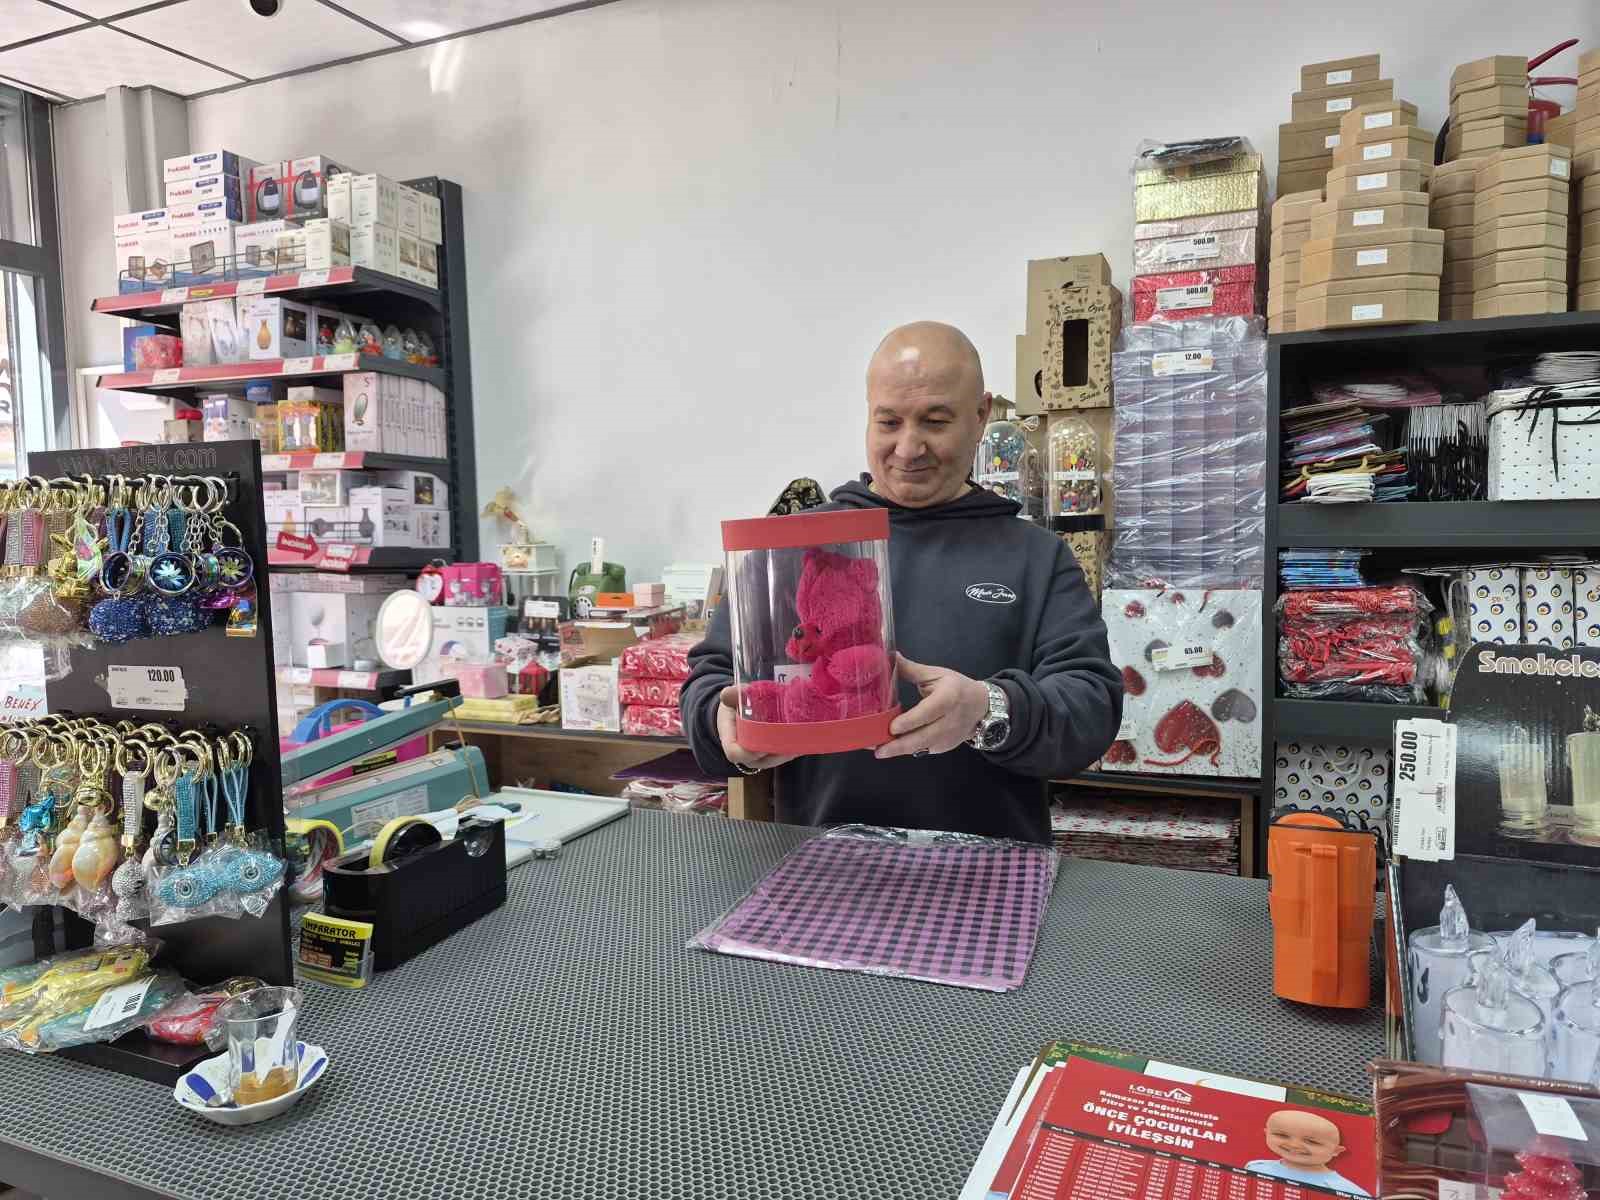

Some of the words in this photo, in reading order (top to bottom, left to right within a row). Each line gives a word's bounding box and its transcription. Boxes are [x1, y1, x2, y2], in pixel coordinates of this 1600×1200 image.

[147, 669, 175, 682] 120.00
[1478, 650, 1600, 678] Smokele
[1398, 730, 1419, 782] 250.00
[1083, 1102, 1129, 1121] ÖNCE
[1133, 1115, 1229, 1144] ÇOCUKLAR
[1108, 1120, 1195, 1149] İYİLEŞSİN
